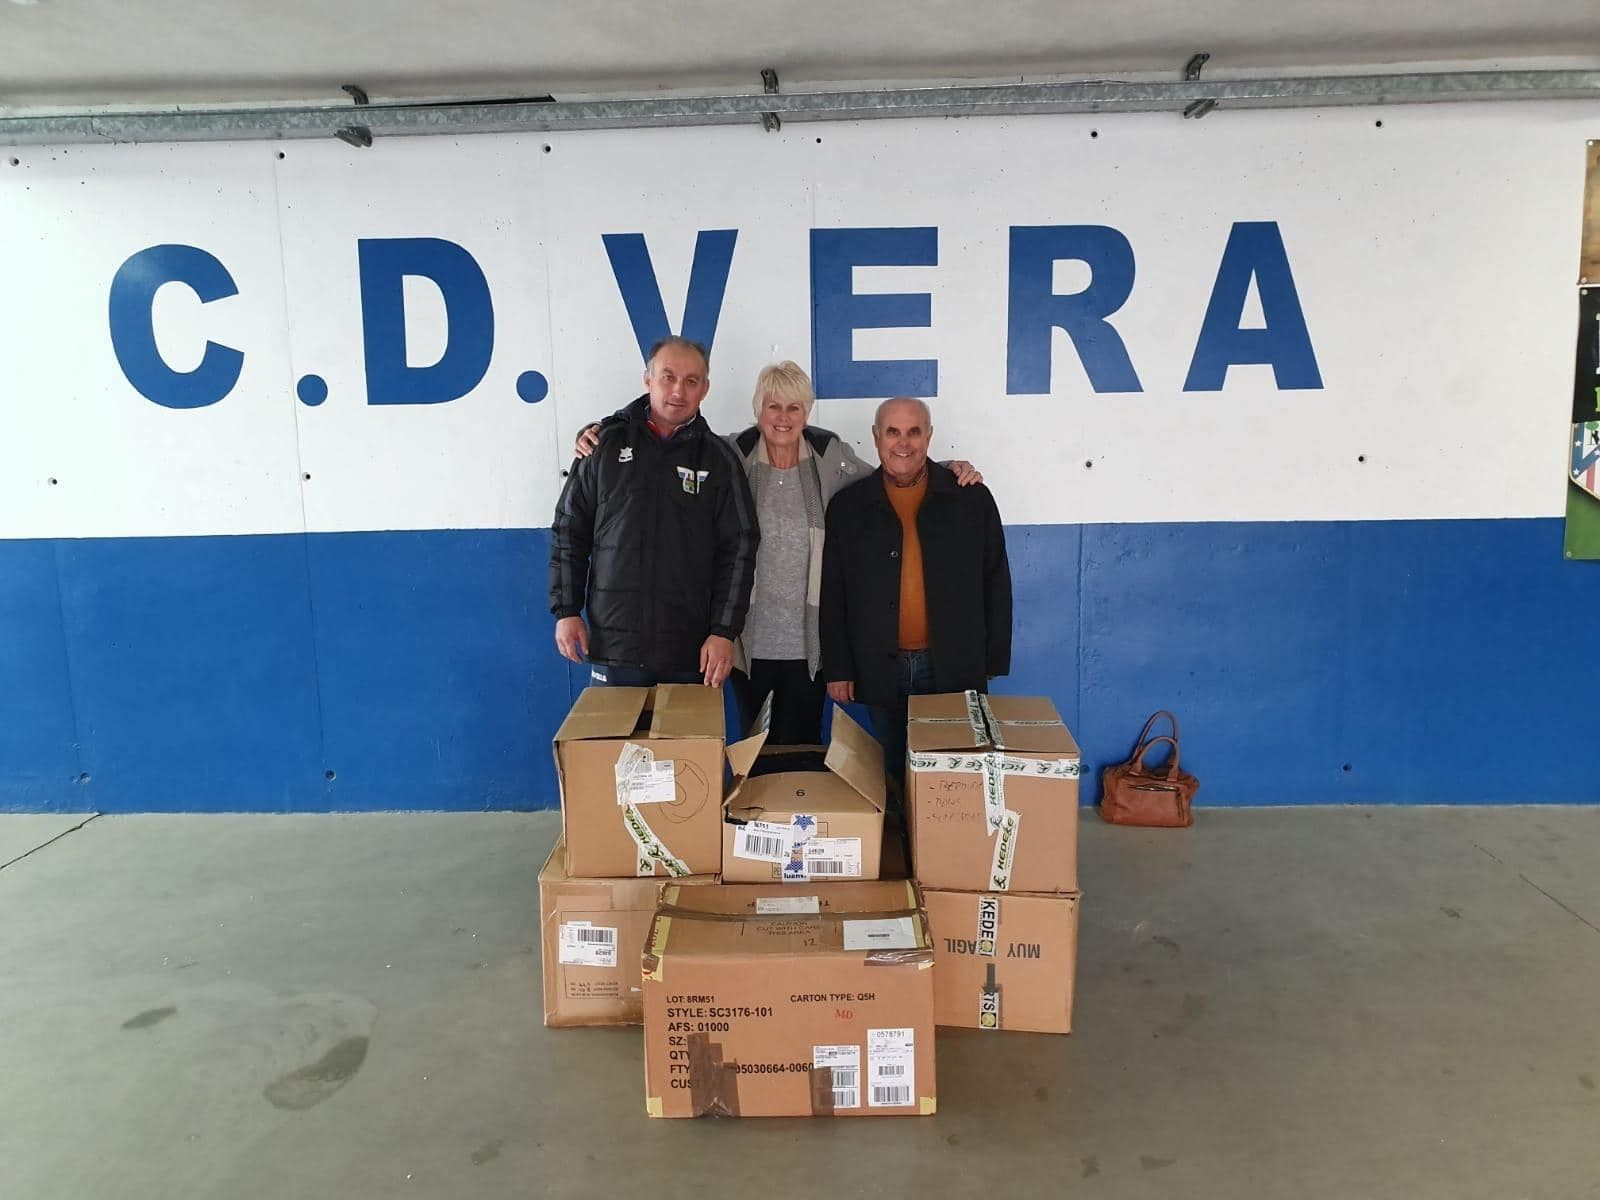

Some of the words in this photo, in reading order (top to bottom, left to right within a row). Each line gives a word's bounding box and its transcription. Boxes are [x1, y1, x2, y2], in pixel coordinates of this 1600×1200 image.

[601, 221, 1324, 400] VERA
[796, 789, 806, 797] 6
[944, 937, 978, 955] AGIL
[1007, 943, 1041, 958] MUY
[667, 995, 685, 1004] LOT:
[687, 995, 715, 1004] 8RM51
[790, 994, 827, 1003] CARTON
[830, 993, 855, 1001] TYPE:
[667, 1008, 707, 1018] STYLE:
[709, 1007, 773, 1017] SC3176-101
[668, 1022, 694, 1032] AFS:
[697, 1022, 729, 1032] 01000
[668, 1036, 686, 1046] SZ:
[671, 1078, 693, 1089] CUS
